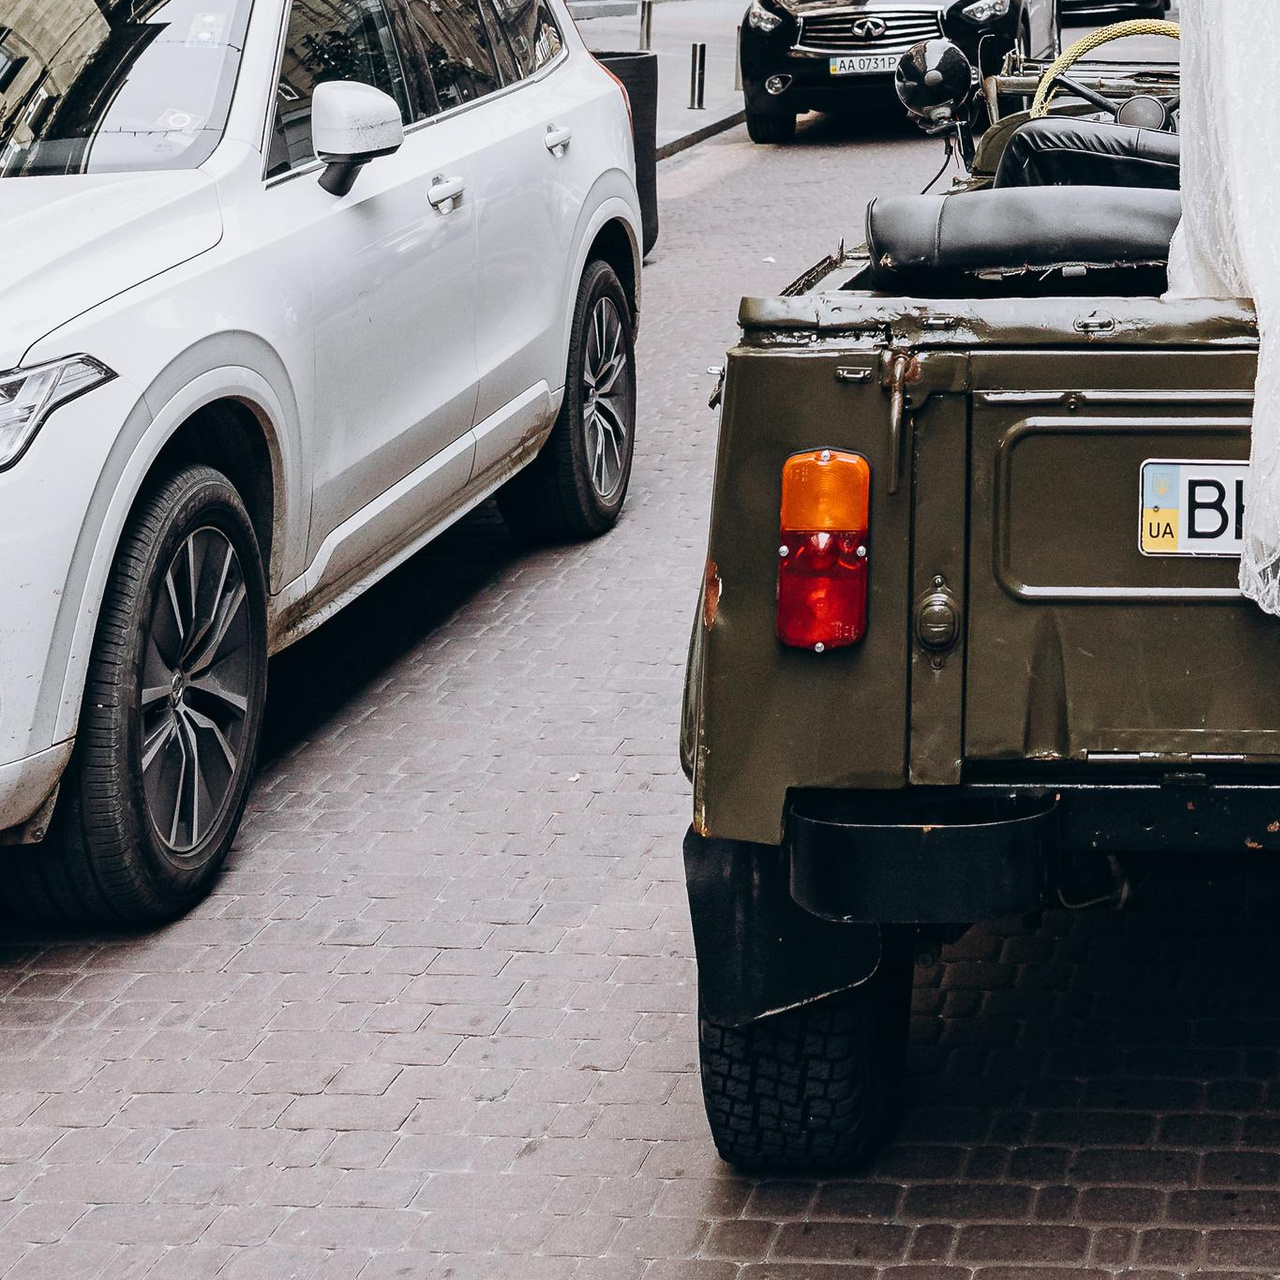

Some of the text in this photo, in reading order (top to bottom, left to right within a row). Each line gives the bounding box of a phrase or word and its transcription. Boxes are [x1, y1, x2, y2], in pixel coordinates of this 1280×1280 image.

[839, 59, 856, 72] AA
[858, 57, 886, 70] 0731
[1149, 522, 1175, 539] UA
